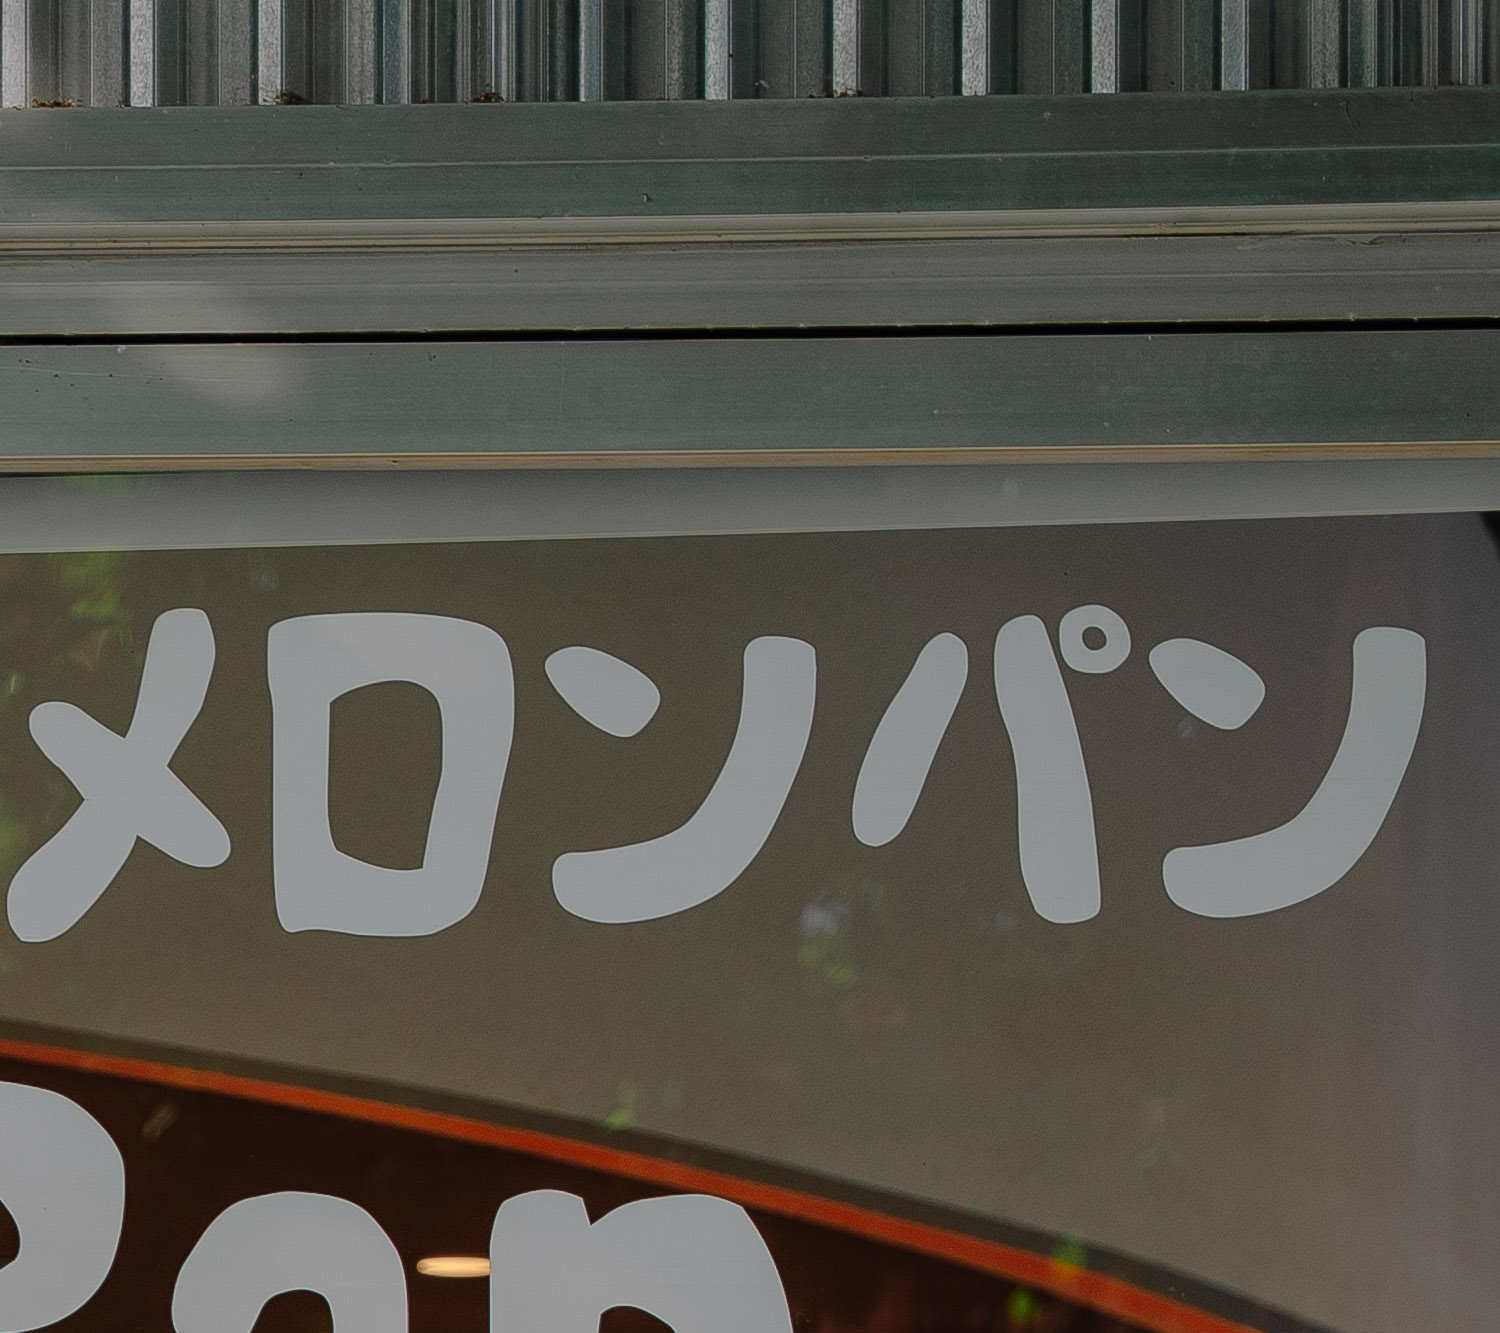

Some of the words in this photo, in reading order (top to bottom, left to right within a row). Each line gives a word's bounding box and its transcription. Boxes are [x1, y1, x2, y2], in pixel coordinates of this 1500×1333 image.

[6, 604, 1428, 943] メロンパン
